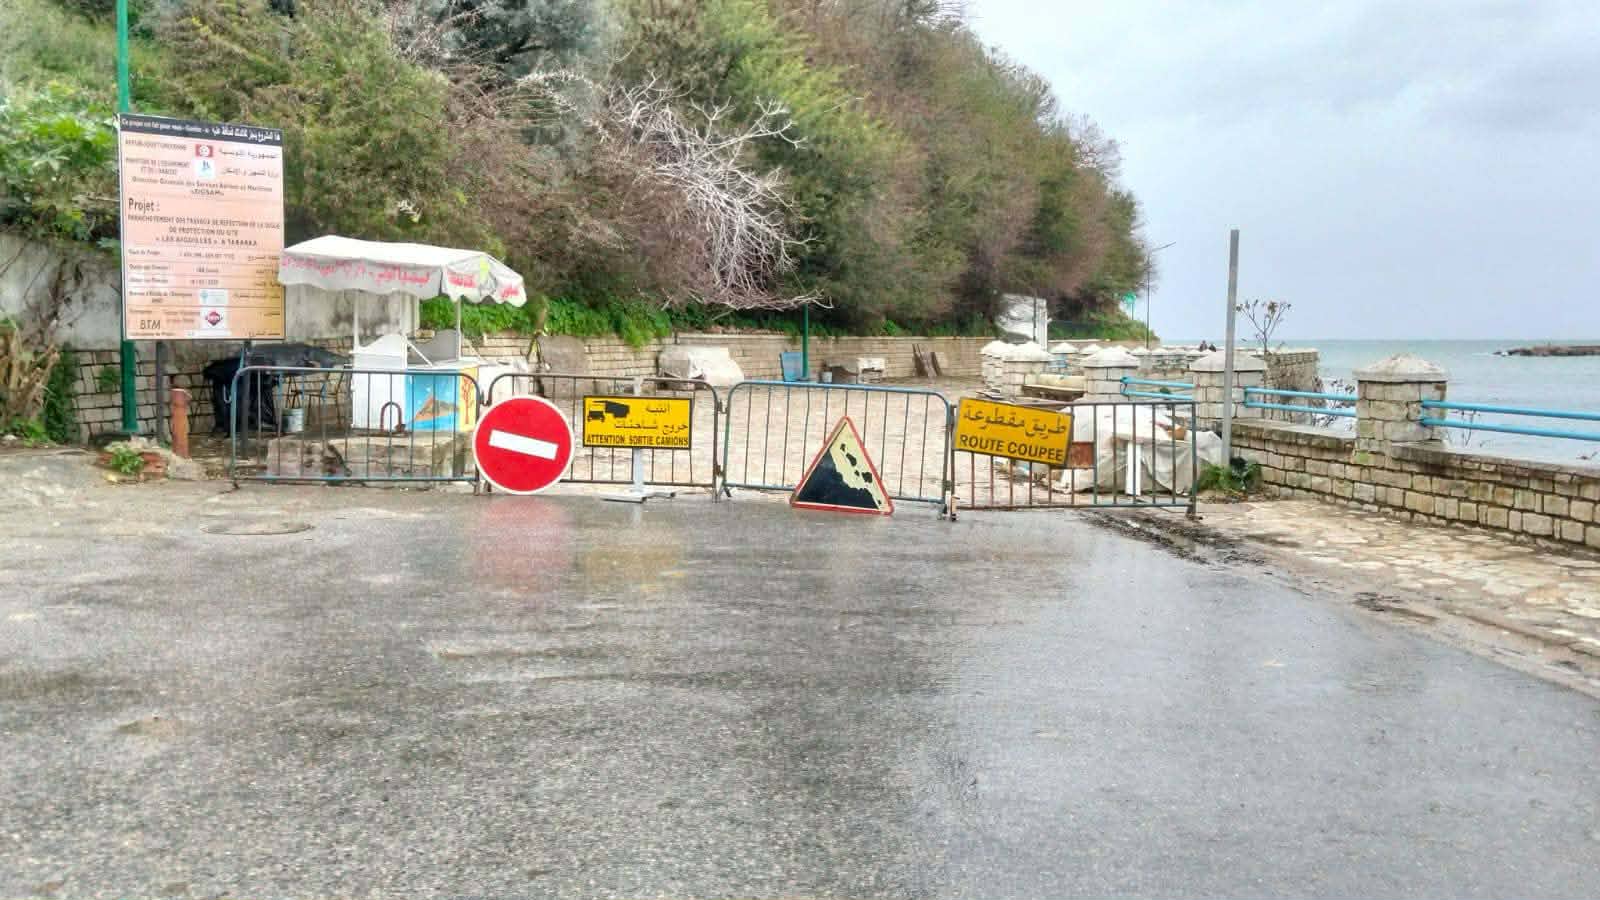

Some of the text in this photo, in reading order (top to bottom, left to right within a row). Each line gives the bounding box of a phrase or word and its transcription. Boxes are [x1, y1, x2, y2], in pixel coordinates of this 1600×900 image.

[128, 197, 154, 214] Projet
[963, 405, 1067, 441] طريق مقطوعة
[586, 435, 689, 446] ATTENTION SORTIE CAMIONS
[959, 434, 1064, 462] ROUTE COUPEE
